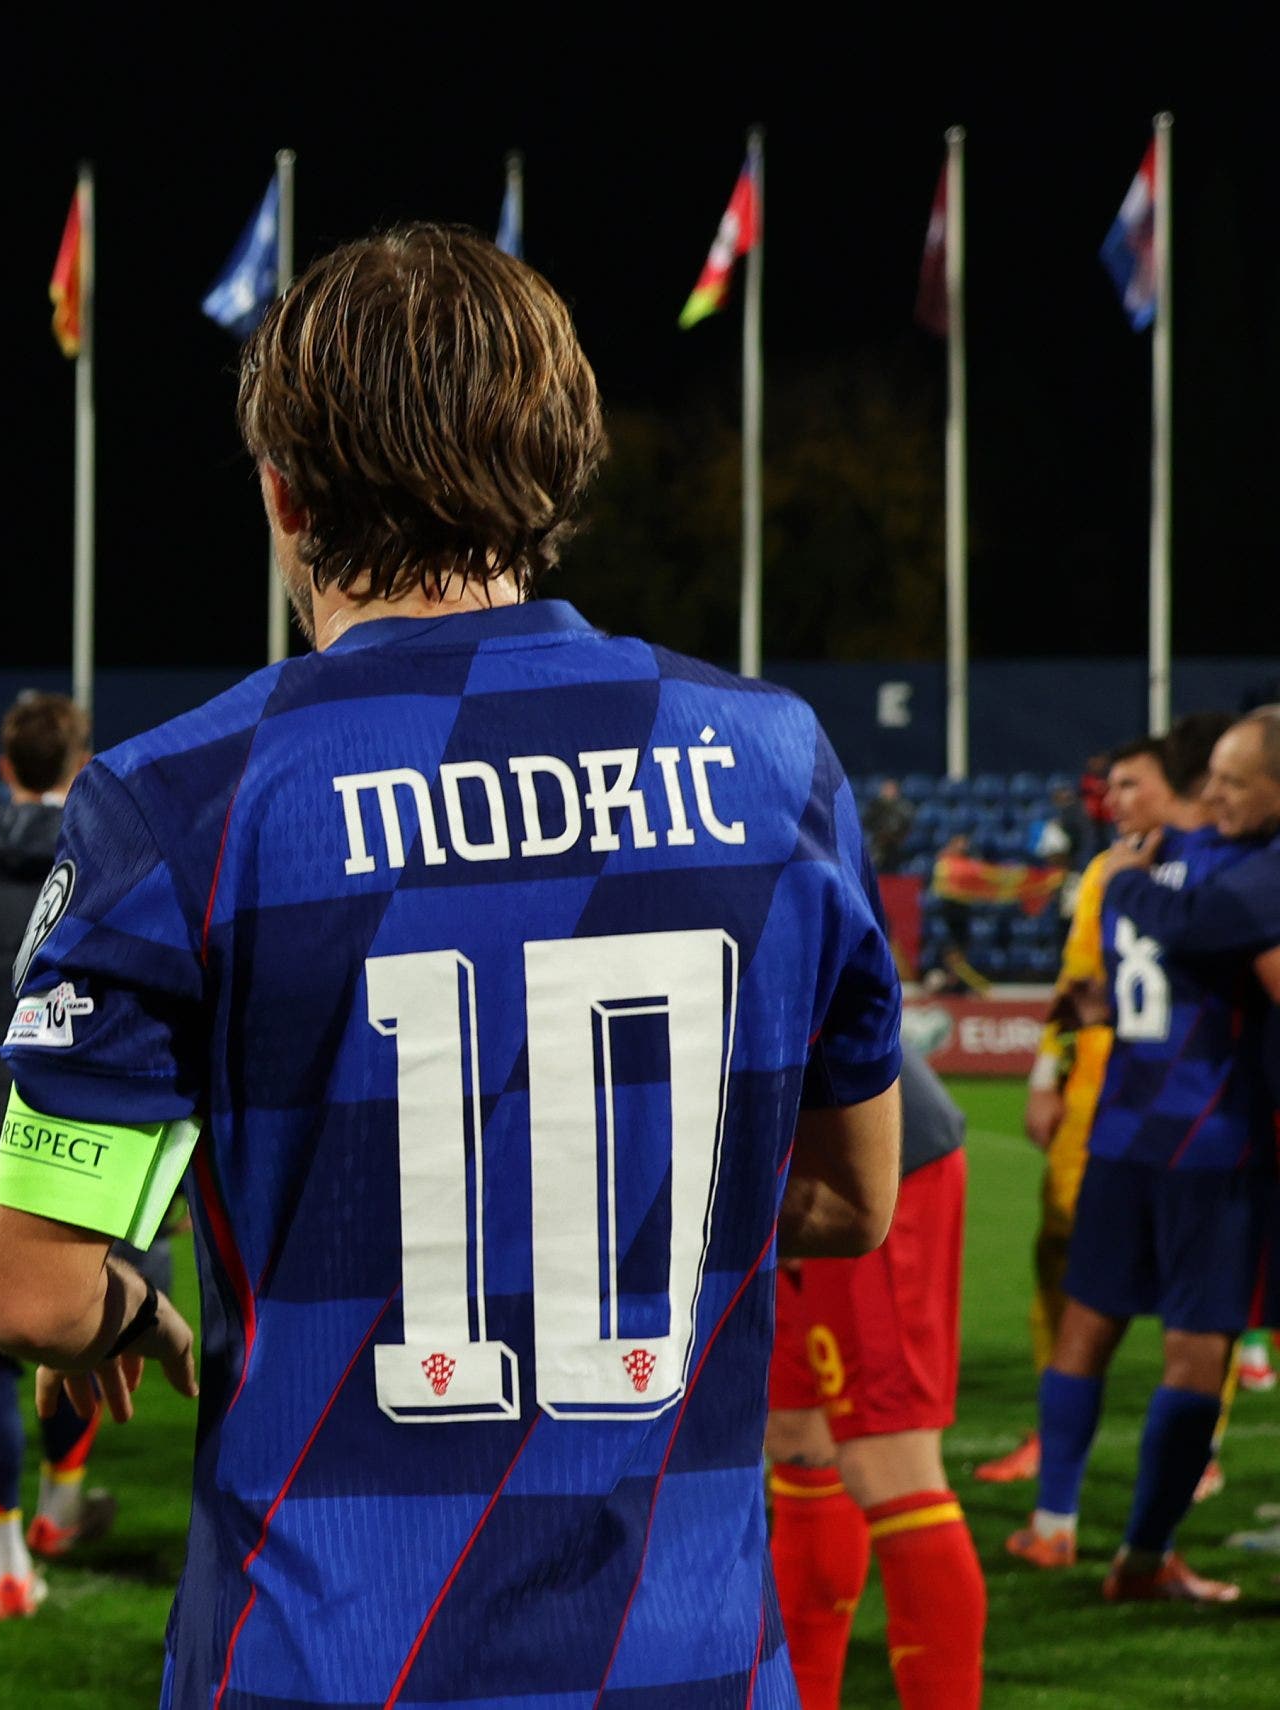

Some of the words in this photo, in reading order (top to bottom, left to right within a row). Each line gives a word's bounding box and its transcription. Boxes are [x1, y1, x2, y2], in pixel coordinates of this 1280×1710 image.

[332, 725, 746, 875] MODRIĆ
[46, 999, 66, 1028] 10
[2, 1120, 109, 1167] RESPECT
[365, 928, 738, 1423] 10
[805, 1324, 845, 1396] 9
